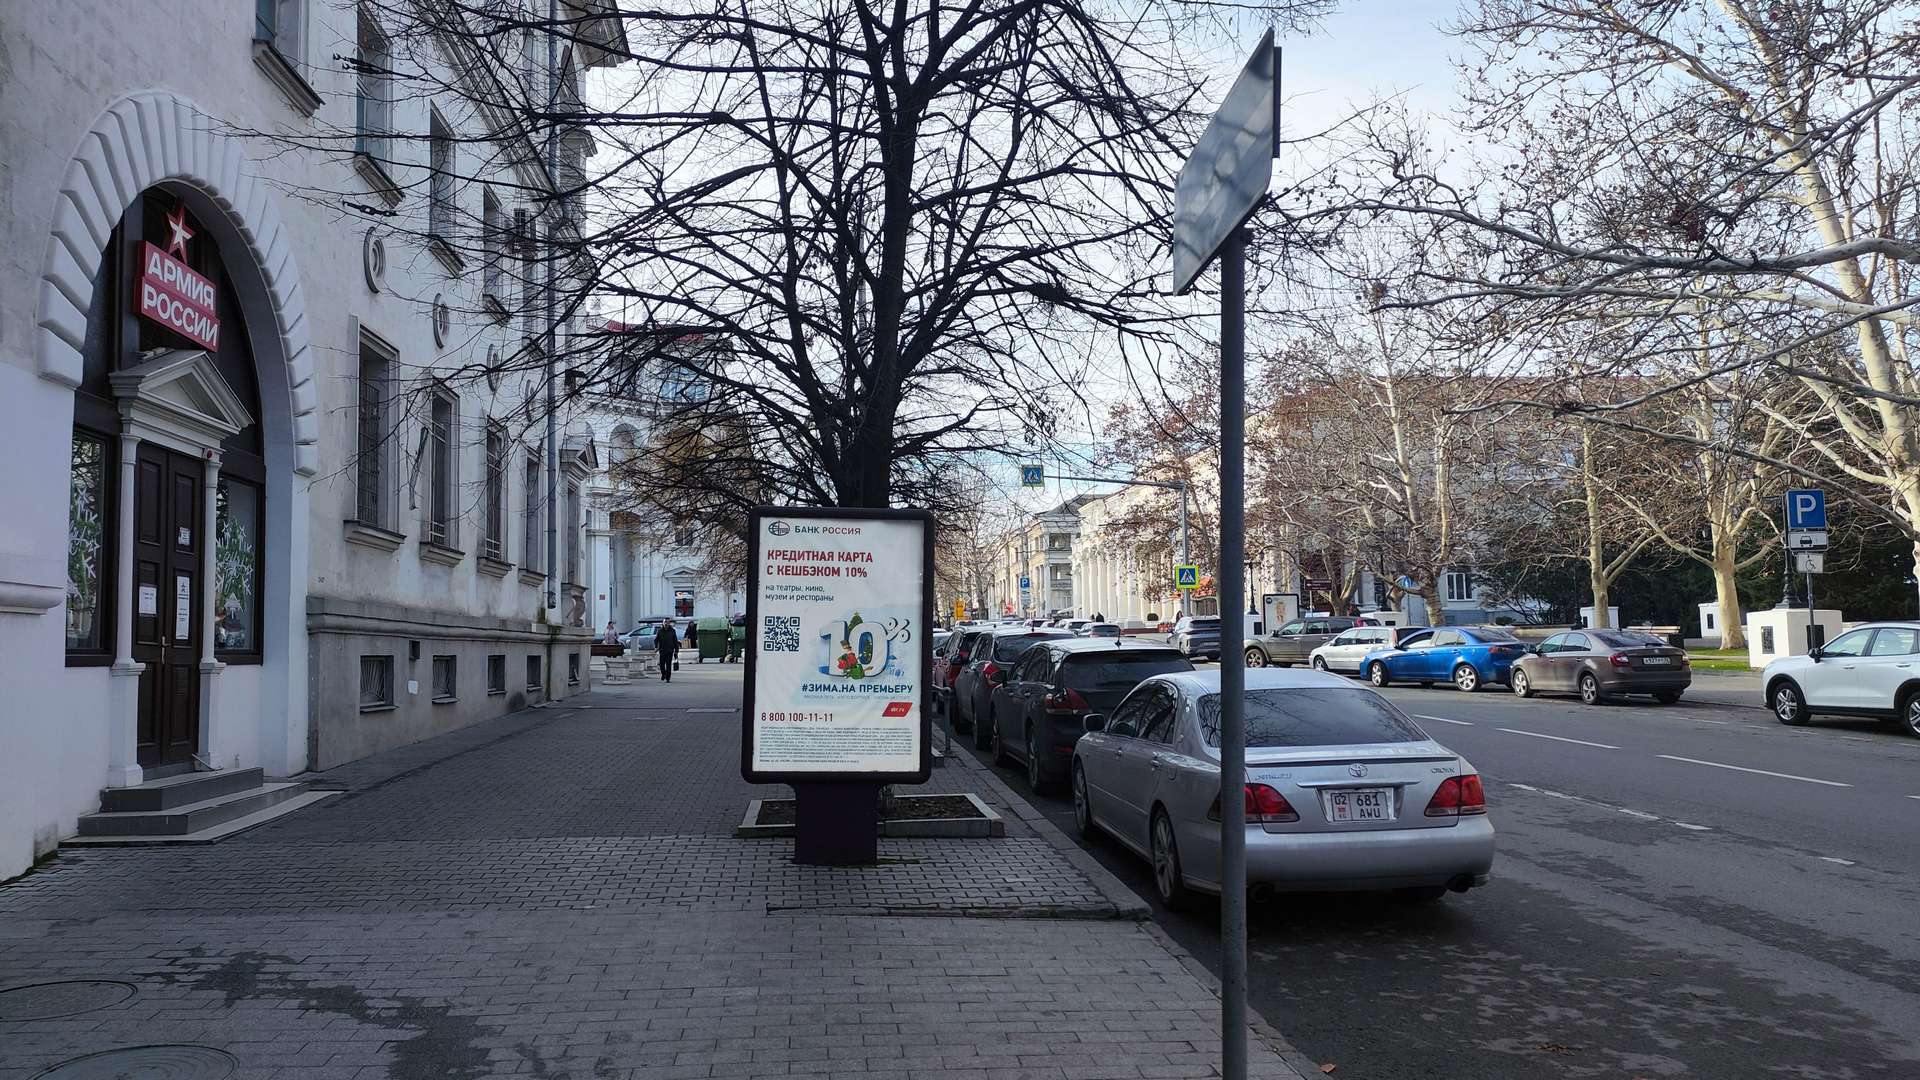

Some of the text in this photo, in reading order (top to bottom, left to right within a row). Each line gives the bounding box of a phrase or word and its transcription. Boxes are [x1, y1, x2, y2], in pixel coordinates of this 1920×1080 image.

[148, 252, 214, 311] АРМИЯ
[143, 283, 218, 347] РОССИИ
[1796, 495, 1817, 524] P
[795, 525, 861, 535] БАНК РОССИЯ
[767, 550, 873, 563] КРЕДИТНАЯ КАРТА
[767, 565, 868, 578] С КЕШБЭКОМ 10%
[765, 594, 787, 602] музеи
[796, 595, 834, 603] рестораны
[818, 617, 911, 680] 10%
[802, 684, 913, 694] #ЗИМА.НА ПРЕМЬЕРУ
[761, 712, 833, 723] 8 800 100-11-11
[1356, 794, 1380, 807] 681
[1359, 808, 1381, 818] AWU
